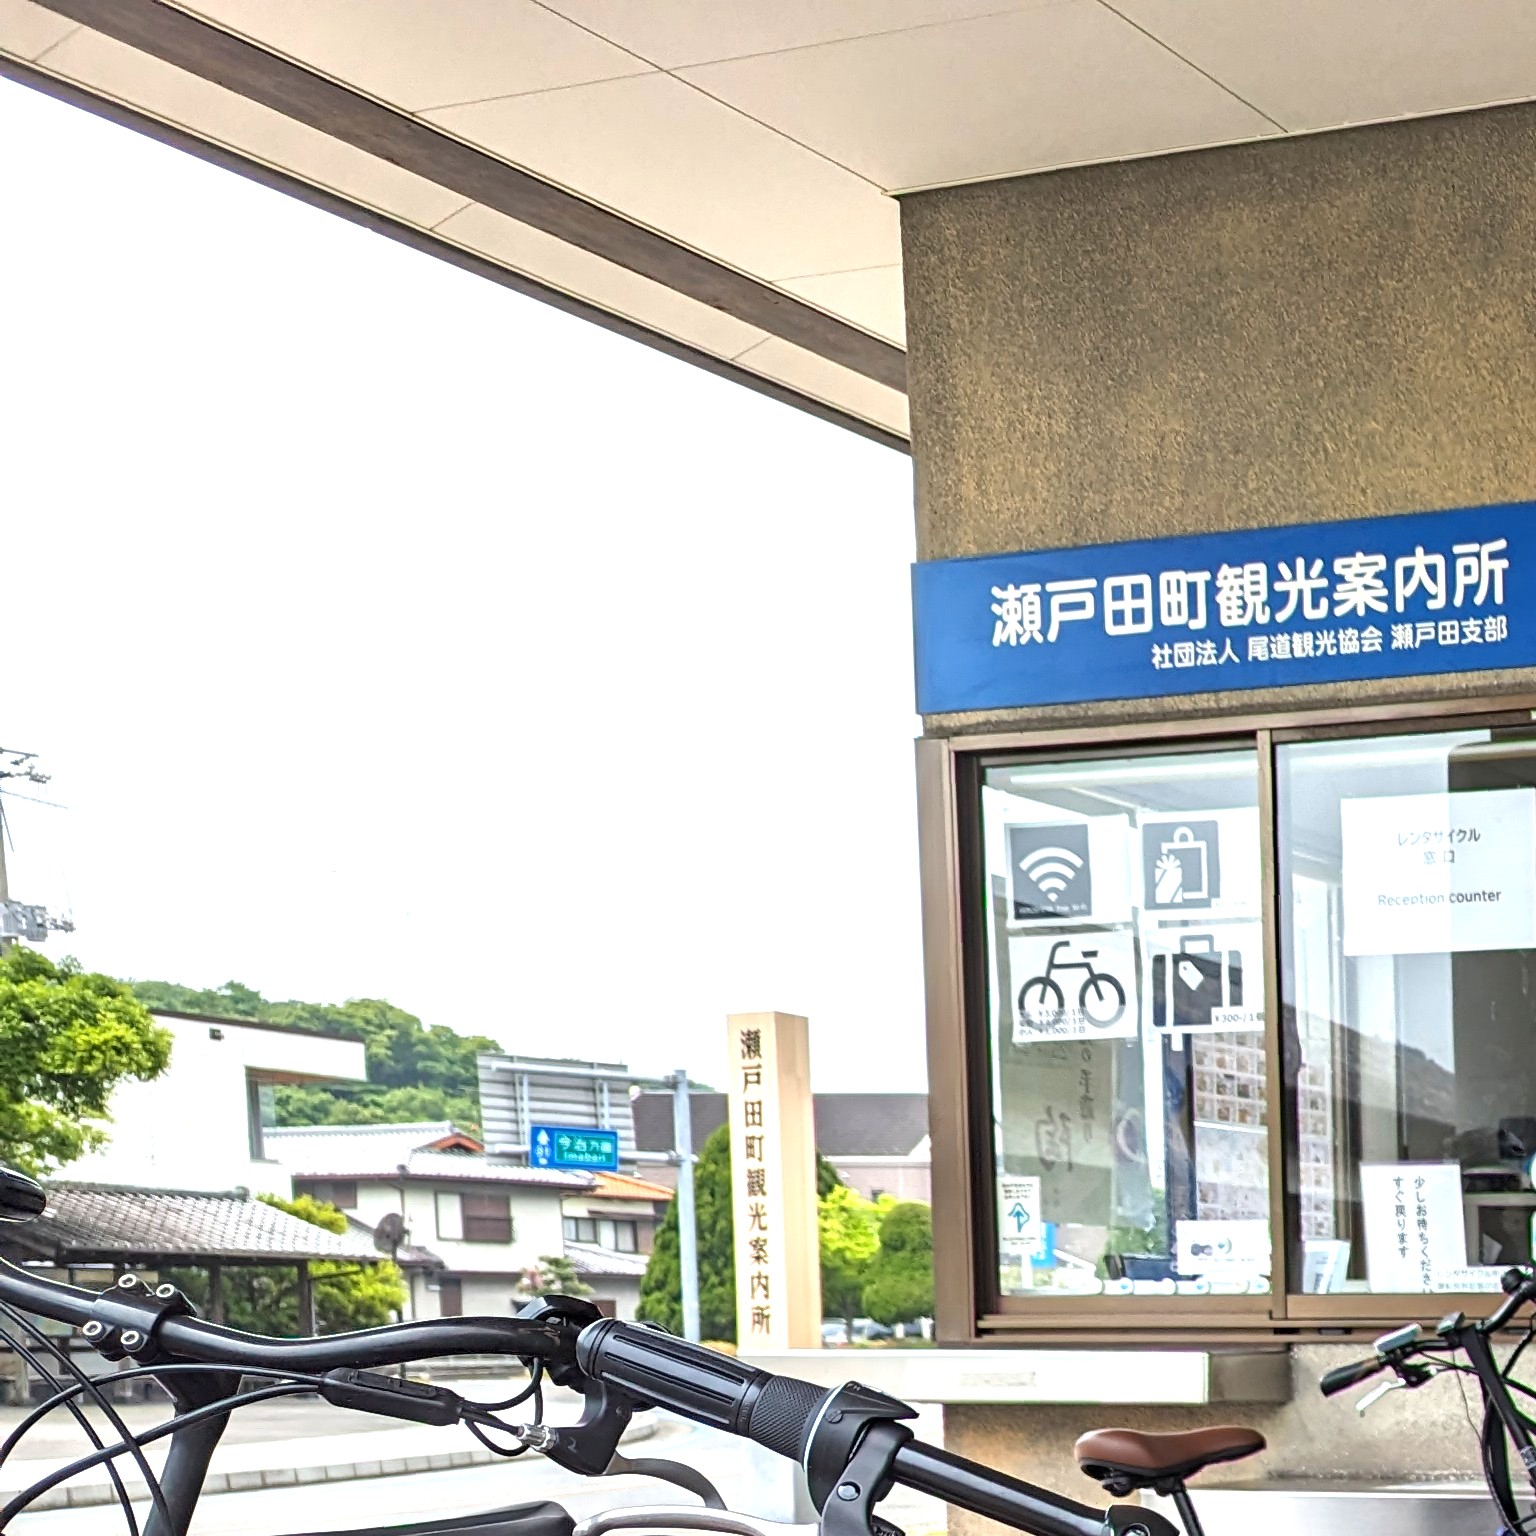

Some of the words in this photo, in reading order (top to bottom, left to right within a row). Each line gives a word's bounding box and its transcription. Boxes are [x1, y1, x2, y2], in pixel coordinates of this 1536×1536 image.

[991, 537, 1510, 648] 瀬戸田町観光案内所
[1151, 641, 1240, 671] 社団法人
[1247, 626, 1382, 660] 尾道観光協会
[1391, 615, 1508, 651] 瀬戸田支部
[1397, 828, 1481, 847] レンタサイクル
[1423, 850, 1456, 865] 窓口
[1377, 893, 1444, 907] Reception
[1448, 890, 1502, 905] counter
[739, 1028, 771, 1335] 瀬戸田町観光案内所
